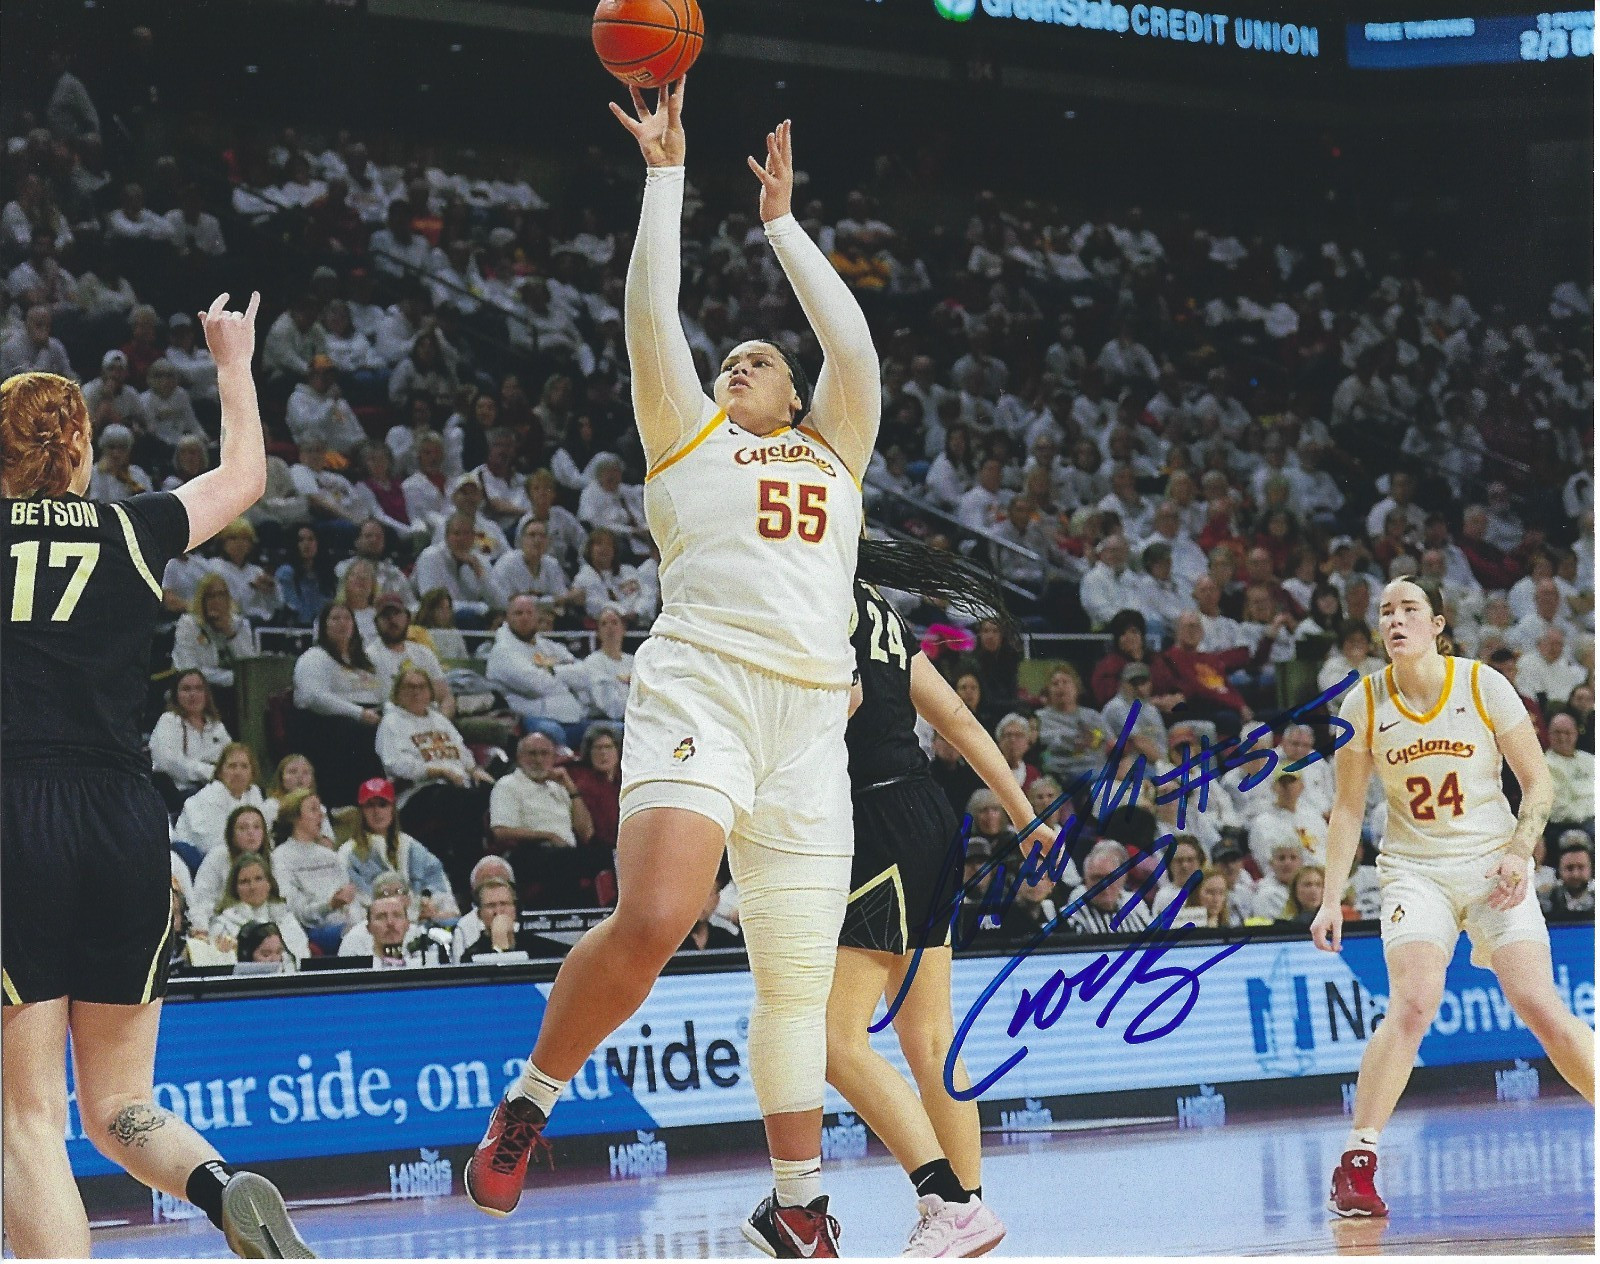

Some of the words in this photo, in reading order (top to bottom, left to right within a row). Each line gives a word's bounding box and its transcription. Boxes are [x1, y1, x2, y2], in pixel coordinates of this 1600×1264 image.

[1131, 3, 1229, 46] CREDIT
[1234, 16, 1319, 57] UNION
[11, 499, 99, 527] BETSON
[756, 479, 828, 544] 55
[10, 540, 100, 622] 17
[866, 600, 907, 671] 24
[1386, 738, 1476, 765] Cyclones
[1405, 771, 1465, 821] 24
[152, 1076, 257, 1131] our
[268, 1049, 408, 1125] side,
[416, 1059, 495, 1112] on
